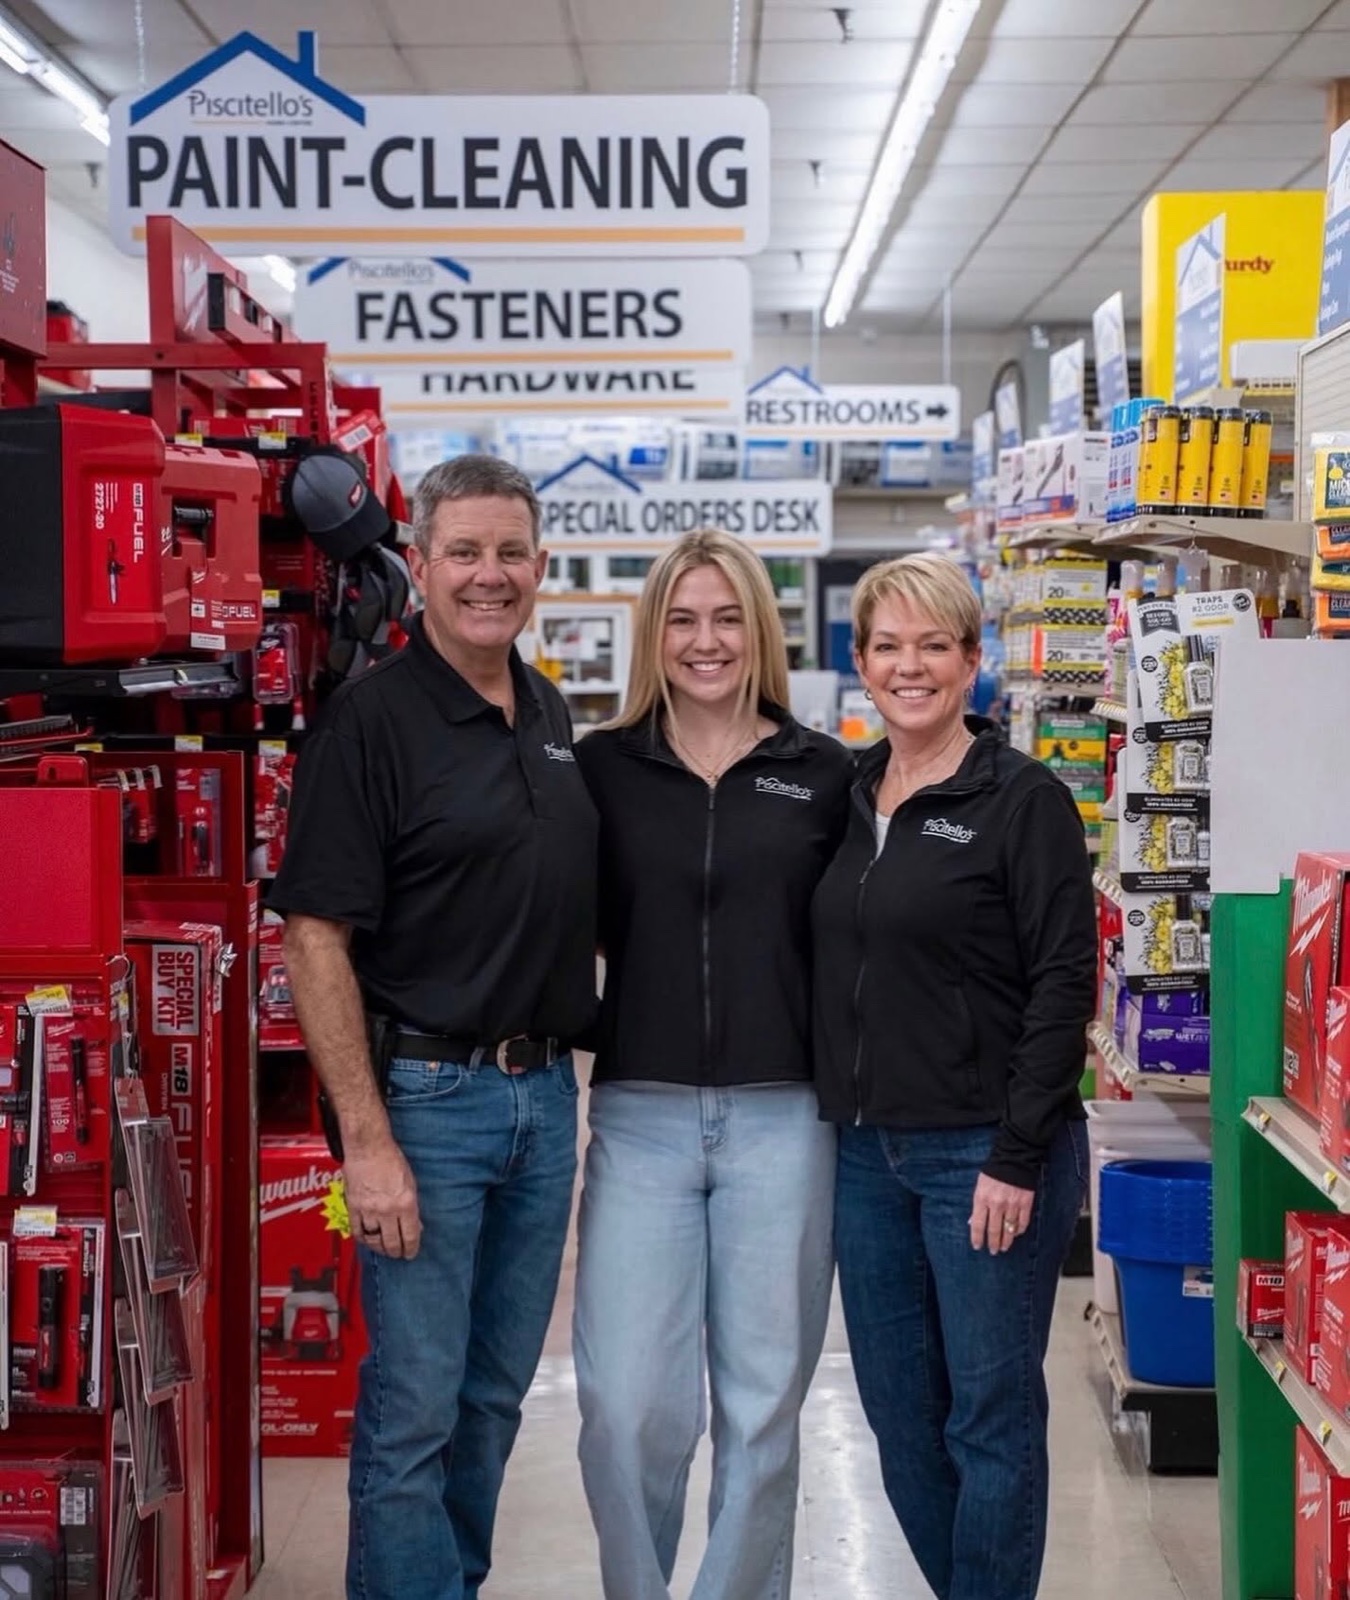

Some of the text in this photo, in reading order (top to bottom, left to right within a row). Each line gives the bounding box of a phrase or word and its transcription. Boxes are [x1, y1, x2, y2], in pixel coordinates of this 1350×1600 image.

[187, 89, 313, 117] Piscitello's
[127, 135, 748, 210] PAINT-CLEANING
[1225, 255, 1277, 275] urdy
[356, 289, 683, 341] FASTENERS
[746, 400, 922, 426] RESTROOMS
[94, 482, 104, 530] 2727-20
[541, 500, 820, 534] PECIAL ORDERS DESK
[133, 508, 144, 563] FUEL
[1047, 586, 1065, 599] 20
[1195, 595, 1223, 605] TRAPS
[228, 605, 256, 618] FUEL
[1047, 650, 1064, 663] 20
[157, 951, 175, 1028] BUY KIT
[176, 951, 194, 1030] SPECIAL
[52, 1118, 70, 1126] 100
[172, 1046, 193, 1213] M18 FU
[1257, 1275, 1284, 1286] M18
